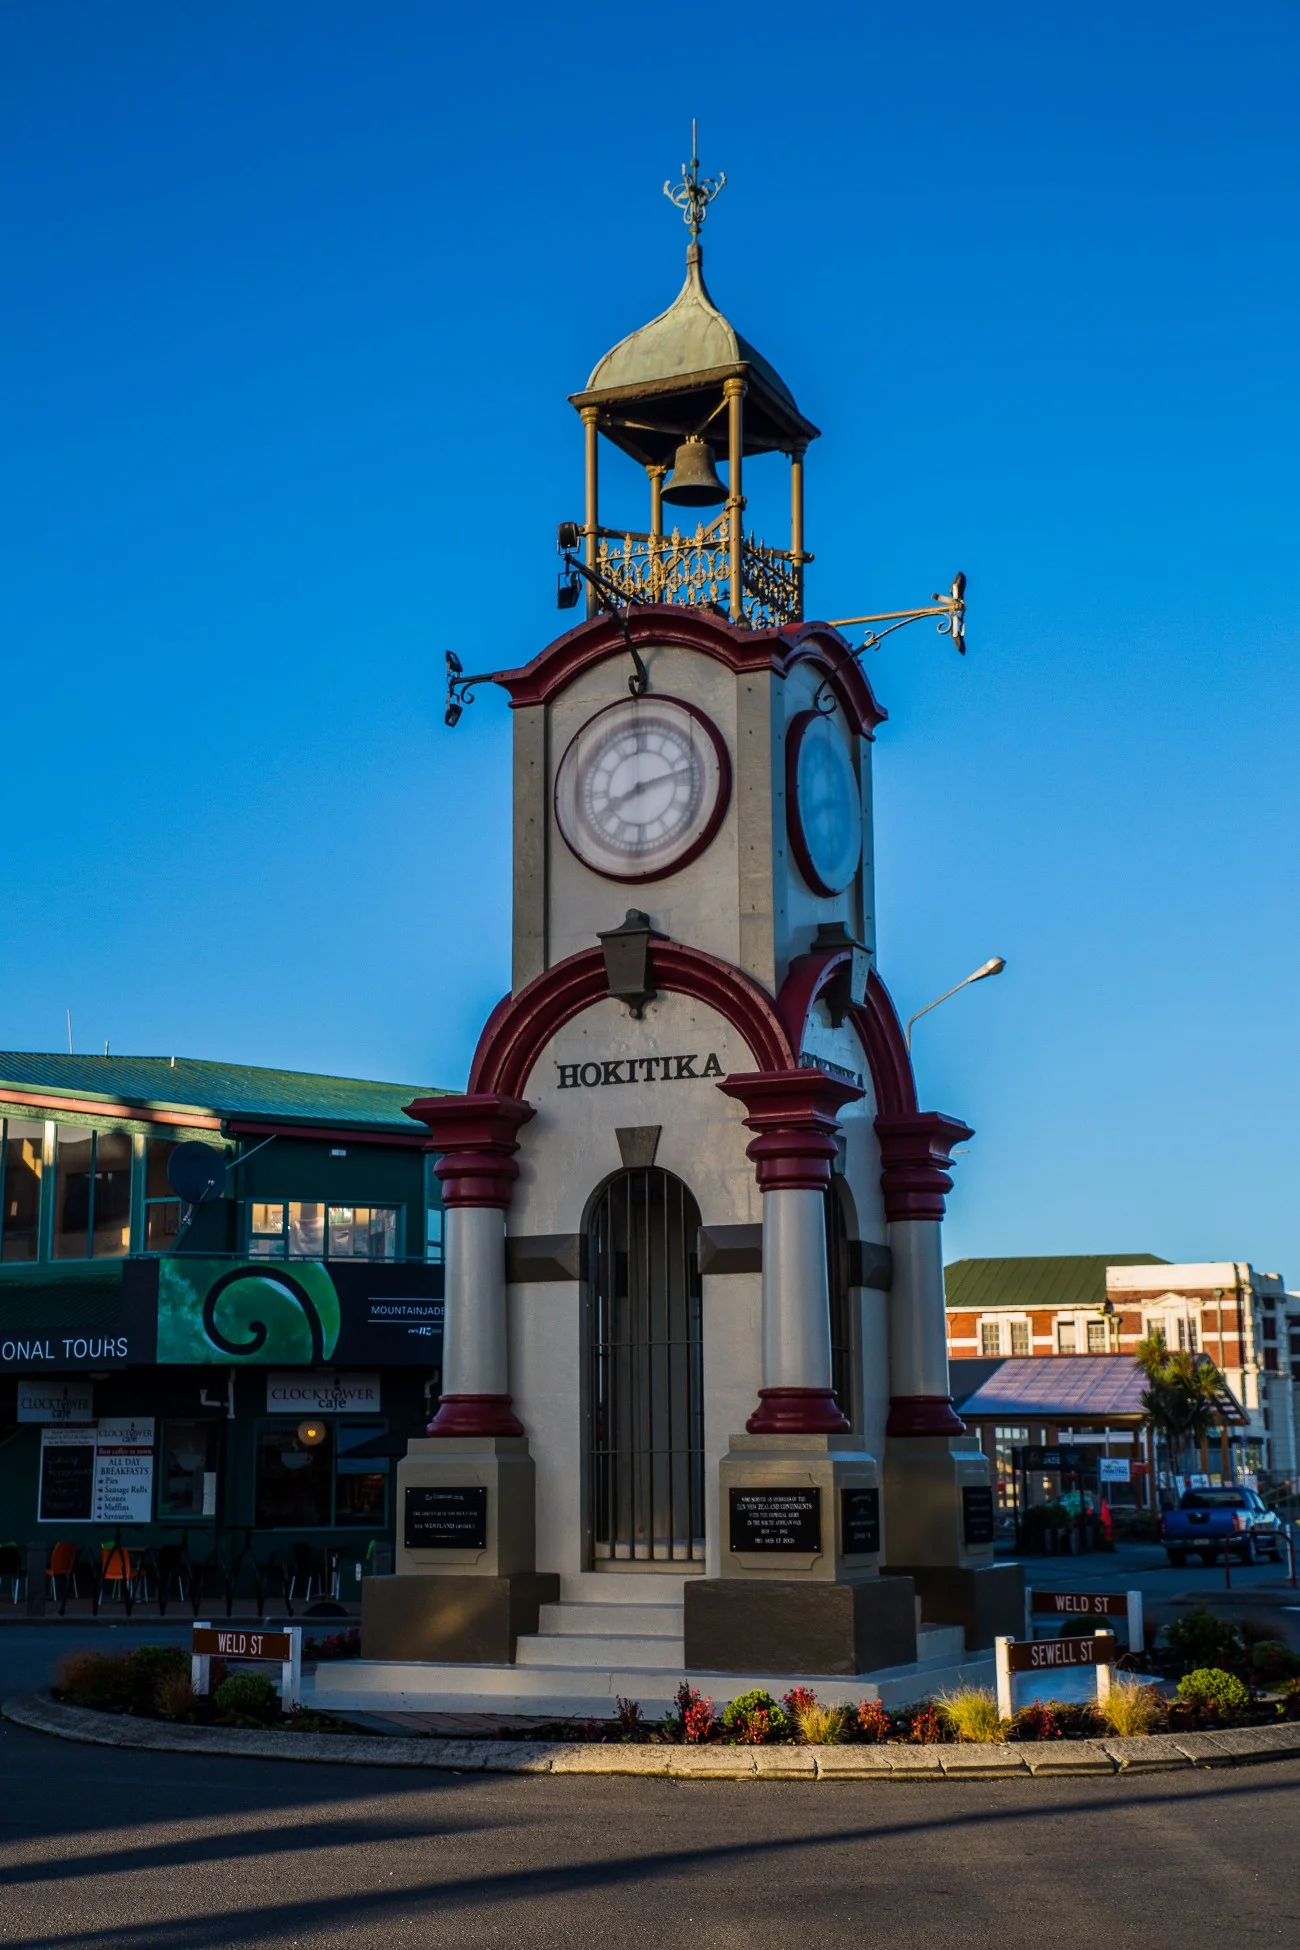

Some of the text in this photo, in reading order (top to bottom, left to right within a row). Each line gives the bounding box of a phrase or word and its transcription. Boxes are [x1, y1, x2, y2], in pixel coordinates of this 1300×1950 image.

[557, 1053, 726, 1089] HOKITIKA
[2, 1337, 128, 1360] ONAL TOURS
[271, 1388, 376, 1400] CLOCKTOWER
[21, 1397, 90, 1410] CLOCKTOWER
[108, 1458, 141, 1466] ALL DAY
[100, 1467, 149, 1475] BREAKFASTS
[105, 1485, 147, 1495] Sausage Rolls
[104, 1503, 129, 1511] Muffins
[103, 1512, 133, 1520] Savouries
[1055, 1595, 1109, 1613] WELD ST
[218, 1633, 263, 1655] WELD ST
[1031, 1641, 1094, 1666] SEWELL ST
